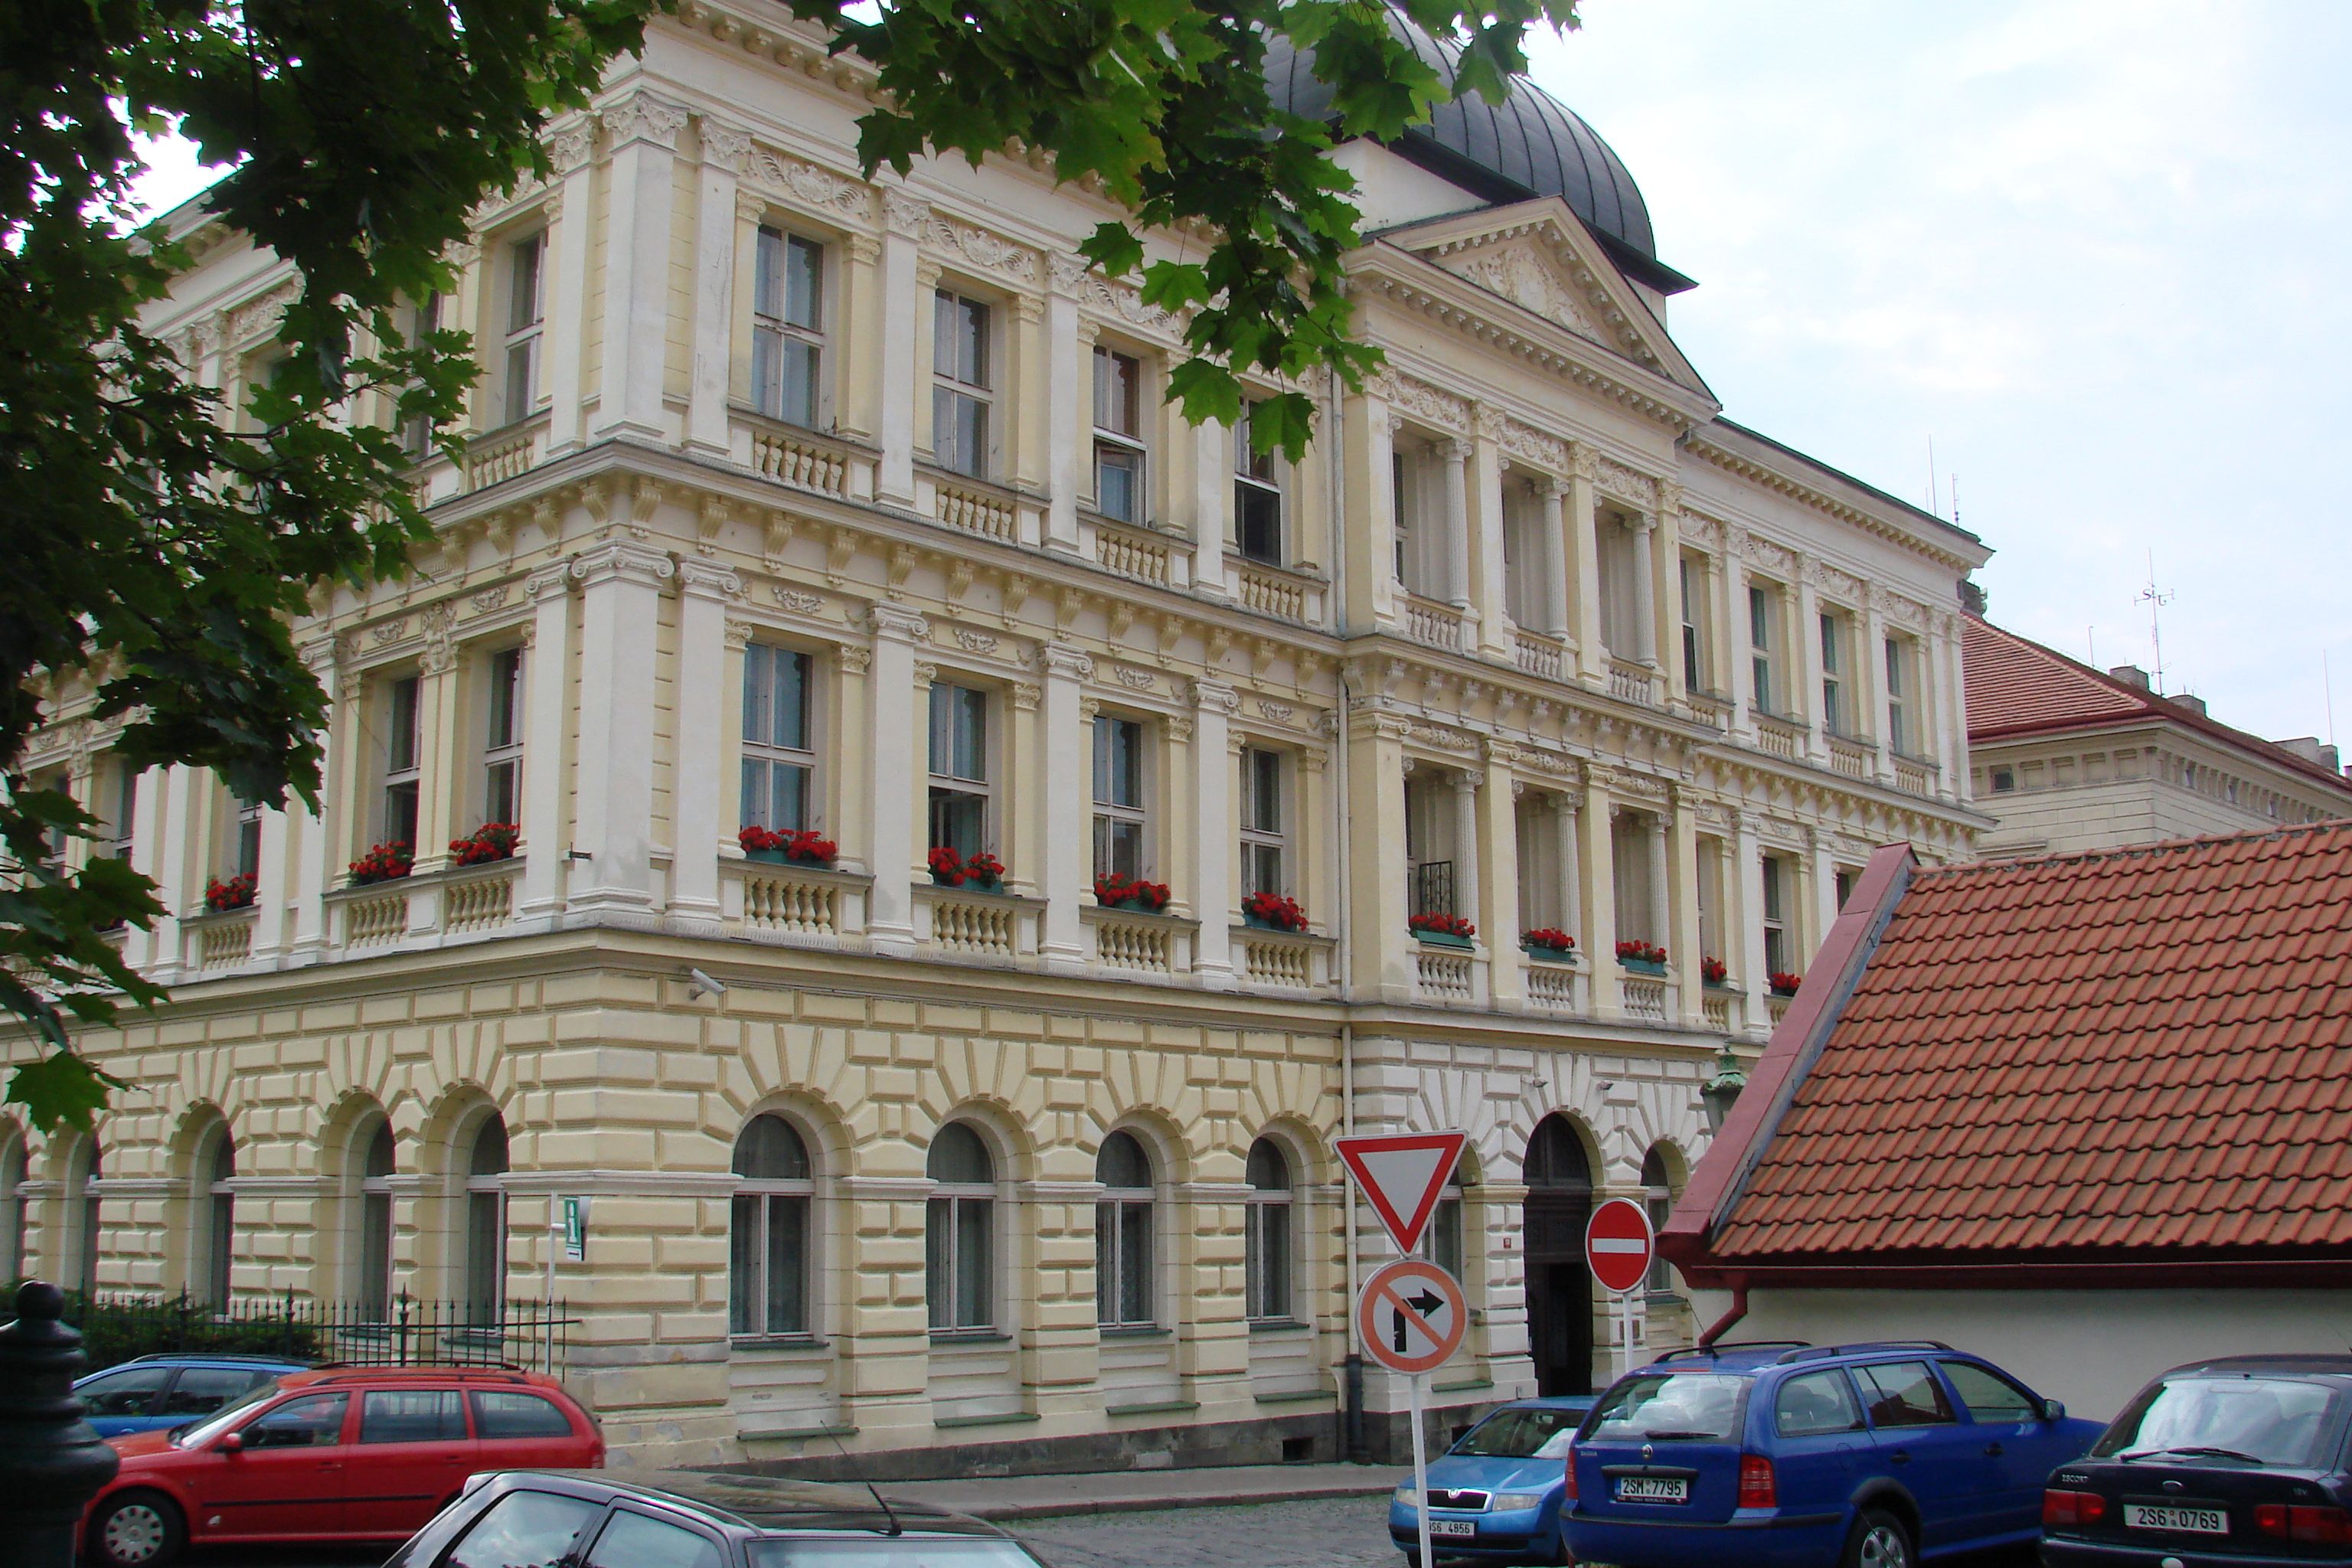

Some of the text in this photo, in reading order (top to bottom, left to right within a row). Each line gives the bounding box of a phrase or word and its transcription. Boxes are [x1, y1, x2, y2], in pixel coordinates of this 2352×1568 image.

[1623, 1479, 1644, 1494] 2SM
[1651, 1480, 1681, 1495] 7795
[2138, 1508, 2219, 1529] 2S6 0769
